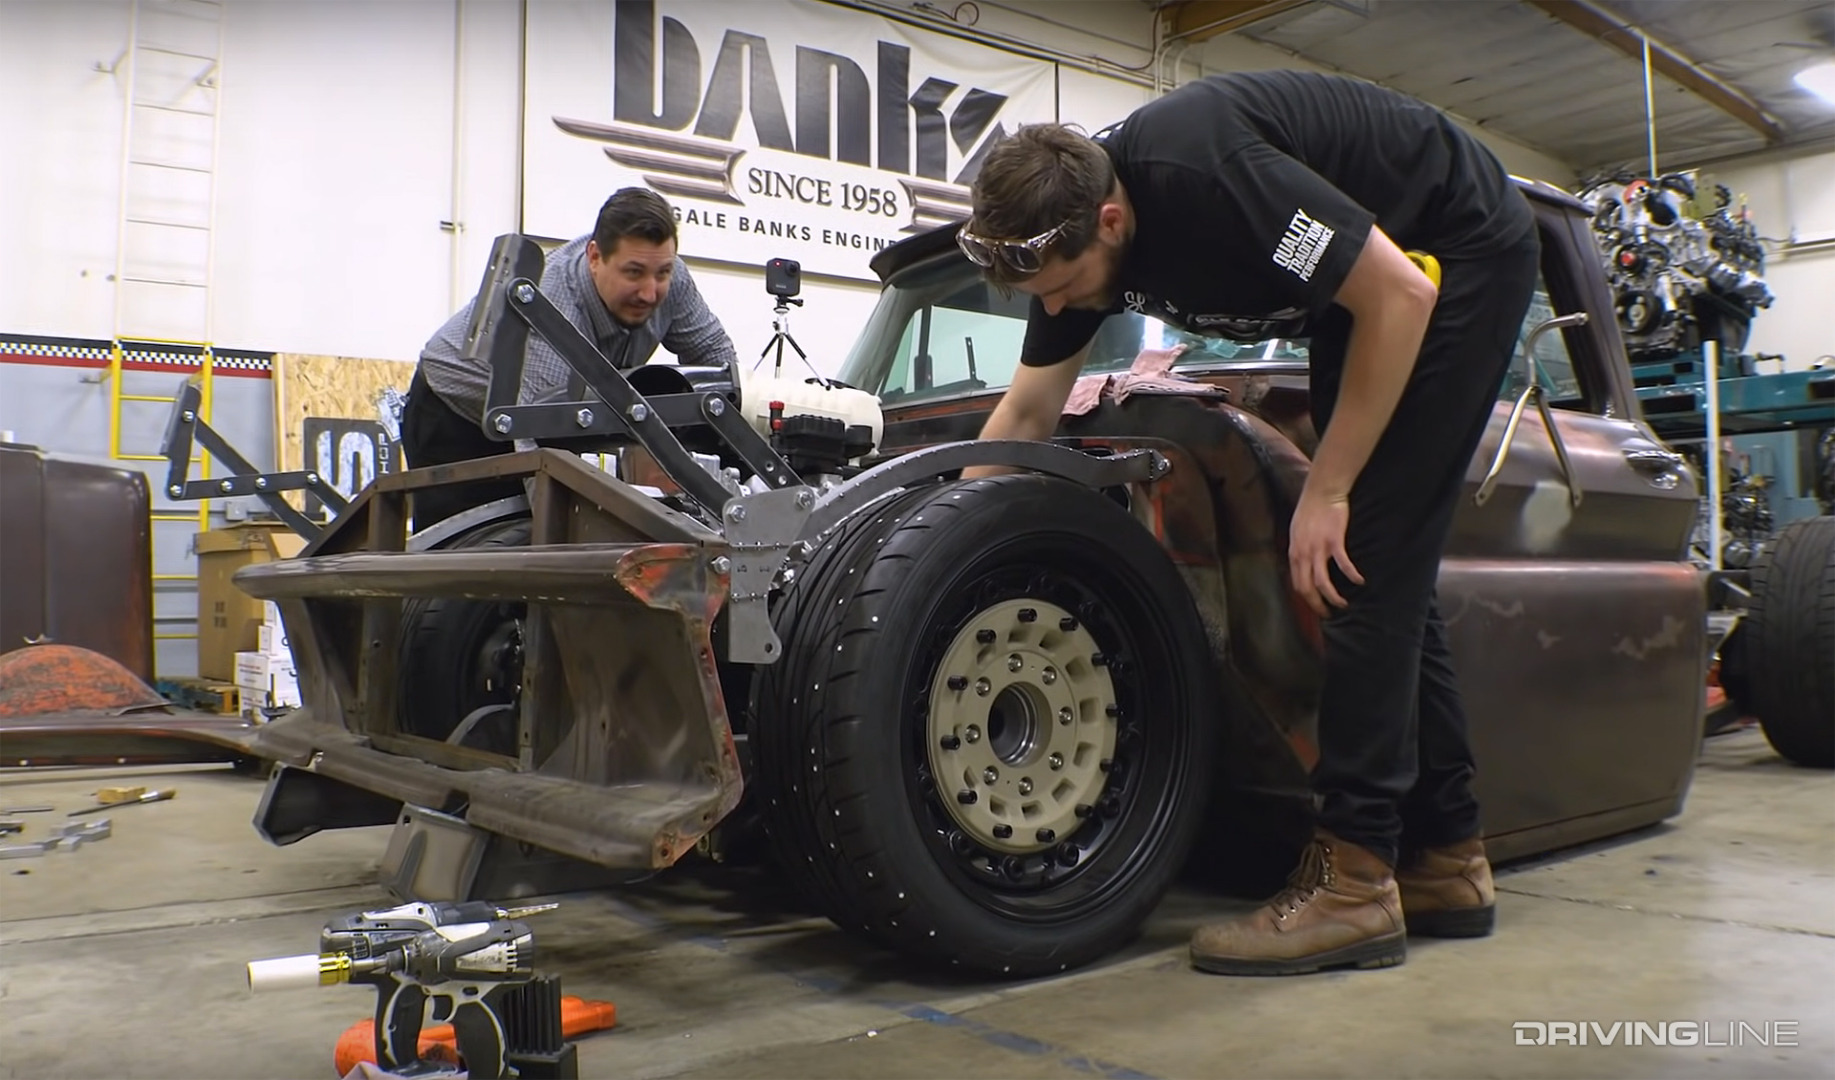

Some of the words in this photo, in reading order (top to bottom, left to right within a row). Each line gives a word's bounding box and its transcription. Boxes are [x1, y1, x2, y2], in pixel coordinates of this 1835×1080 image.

[748, 167, 832, 206] SINCE
[840, 183, 898, 217] 1958
[672, 207, 727, 228] GALE
[739, 217, 811, 241] BANKS
[1272, 208, 1312, 267] QUALITY
[1287, 219, 1325, 274] TRADITION
[1299, 226, 1335, 282] PERFORMANCE
